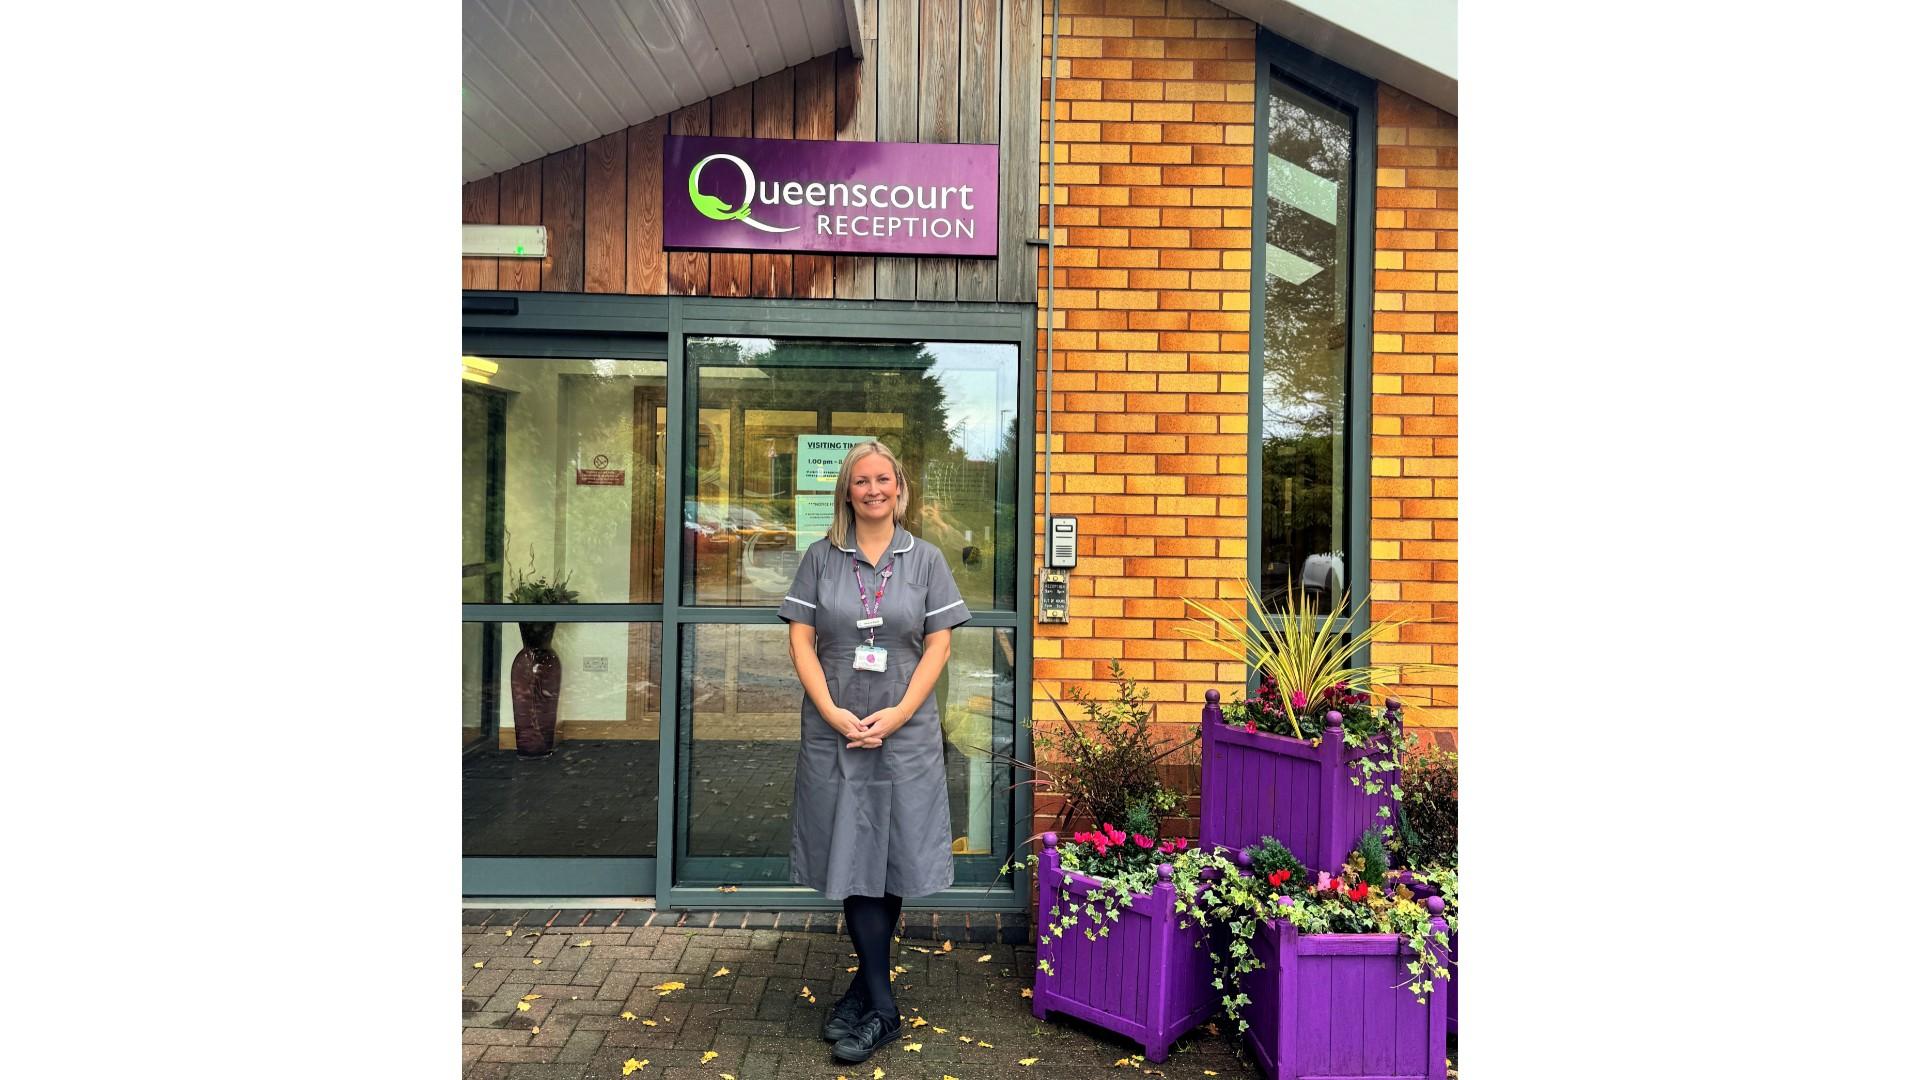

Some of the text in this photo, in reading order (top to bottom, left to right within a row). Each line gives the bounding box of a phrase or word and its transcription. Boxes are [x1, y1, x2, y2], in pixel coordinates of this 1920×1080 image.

[689, 153, 975, 233] Queenscourt
[816, 215, 976, 239] RECEPTION
[807, 441, 842, 449] VISITING
